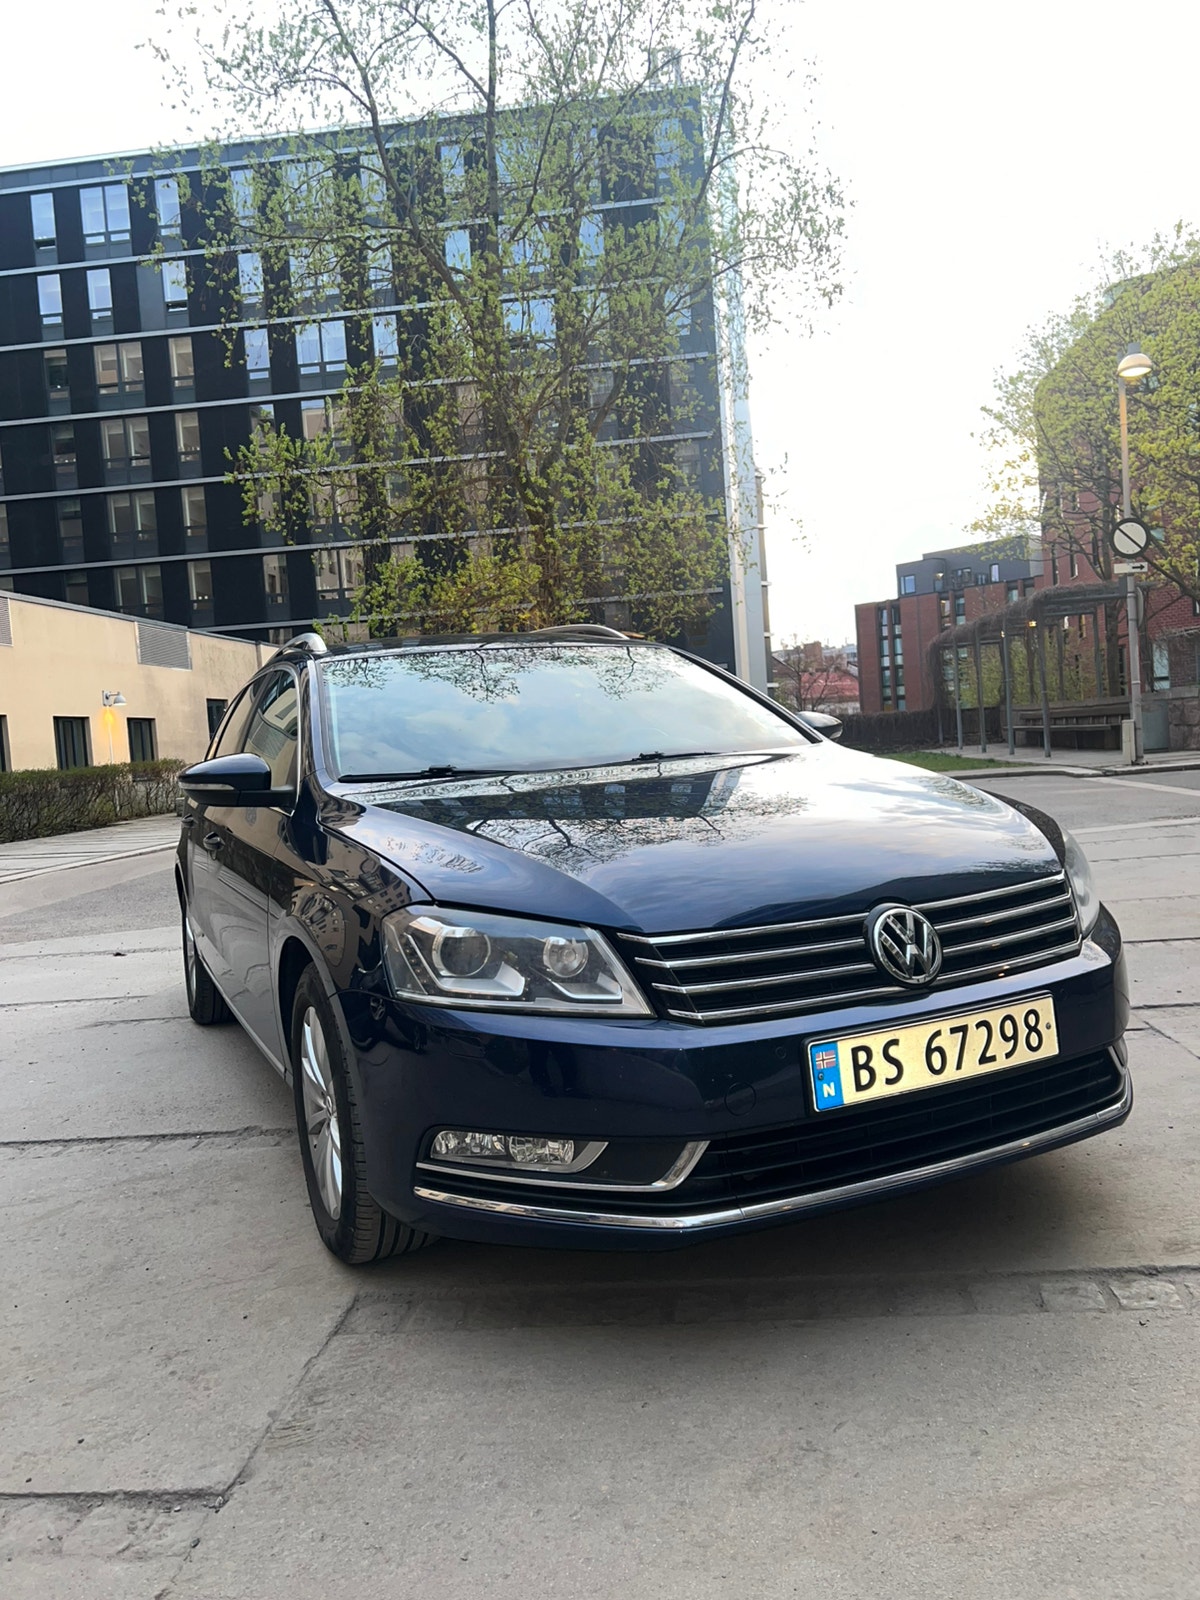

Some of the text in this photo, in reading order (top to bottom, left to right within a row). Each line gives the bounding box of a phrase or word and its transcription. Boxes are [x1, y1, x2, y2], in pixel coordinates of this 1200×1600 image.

[850, 1008, 1044, 1093] BS 67298
[822, 1081, 836, 1098] N
